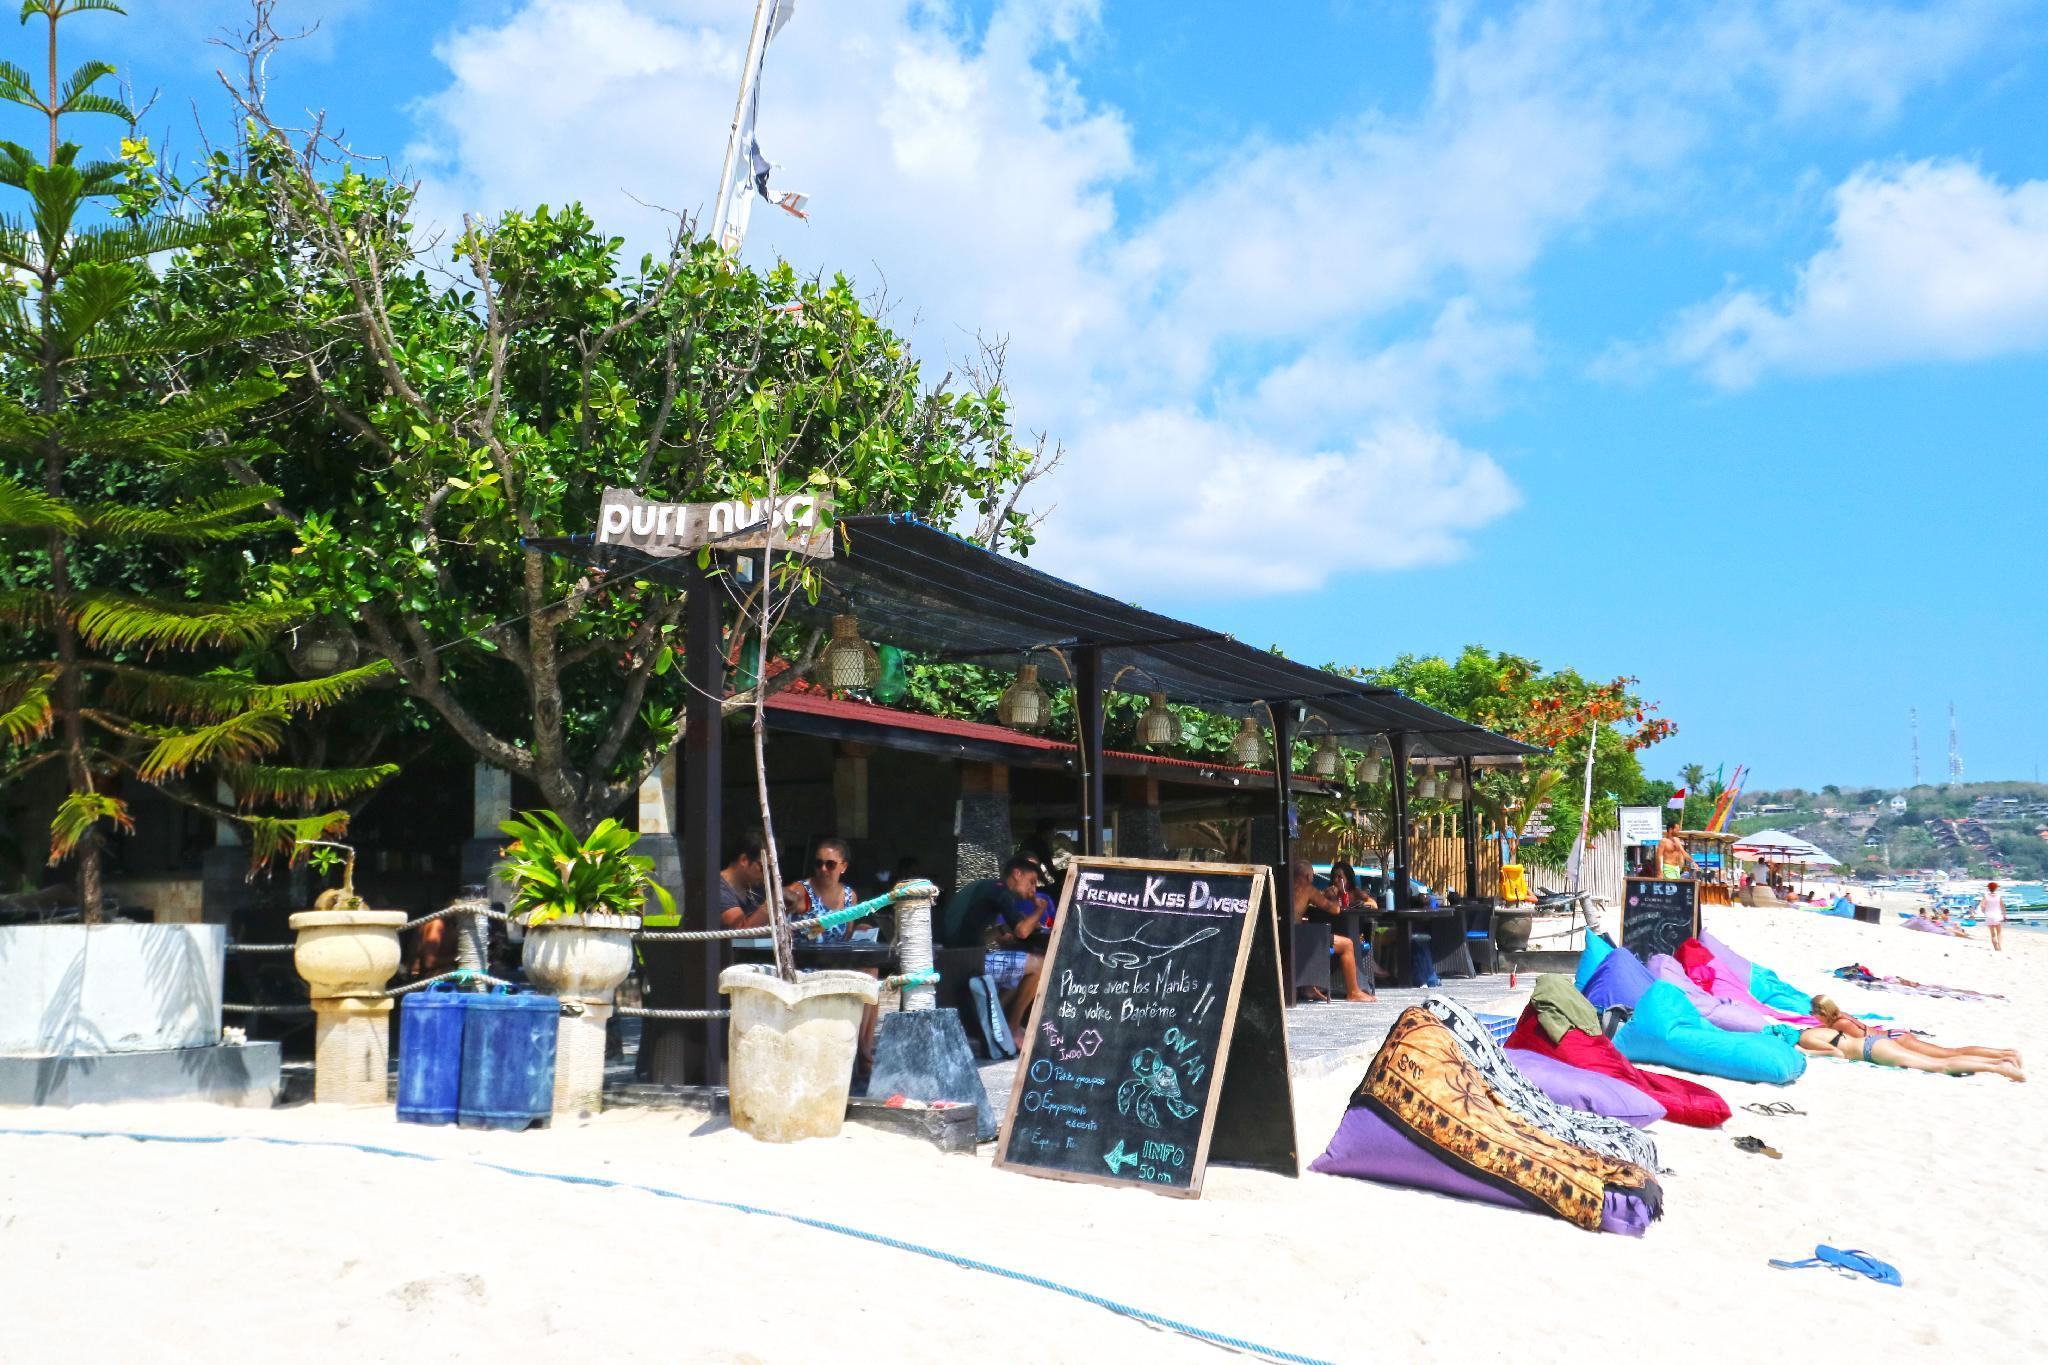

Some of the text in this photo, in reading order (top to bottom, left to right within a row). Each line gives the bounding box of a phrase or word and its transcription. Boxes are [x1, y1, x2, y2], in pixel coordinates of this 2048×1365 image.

[600, 495, 815, 543] puri nusa
[1076, 872, 1249, 914] FRENCH KISS DIVERS
[1060, 959, 1198, 1005] Plongez avec les Mantas
[1050, 1035, 1064, 1047] EN
[1142, 1140, 1185, 1167] INFO
[1139, 1164, 1156, 1180] 50
